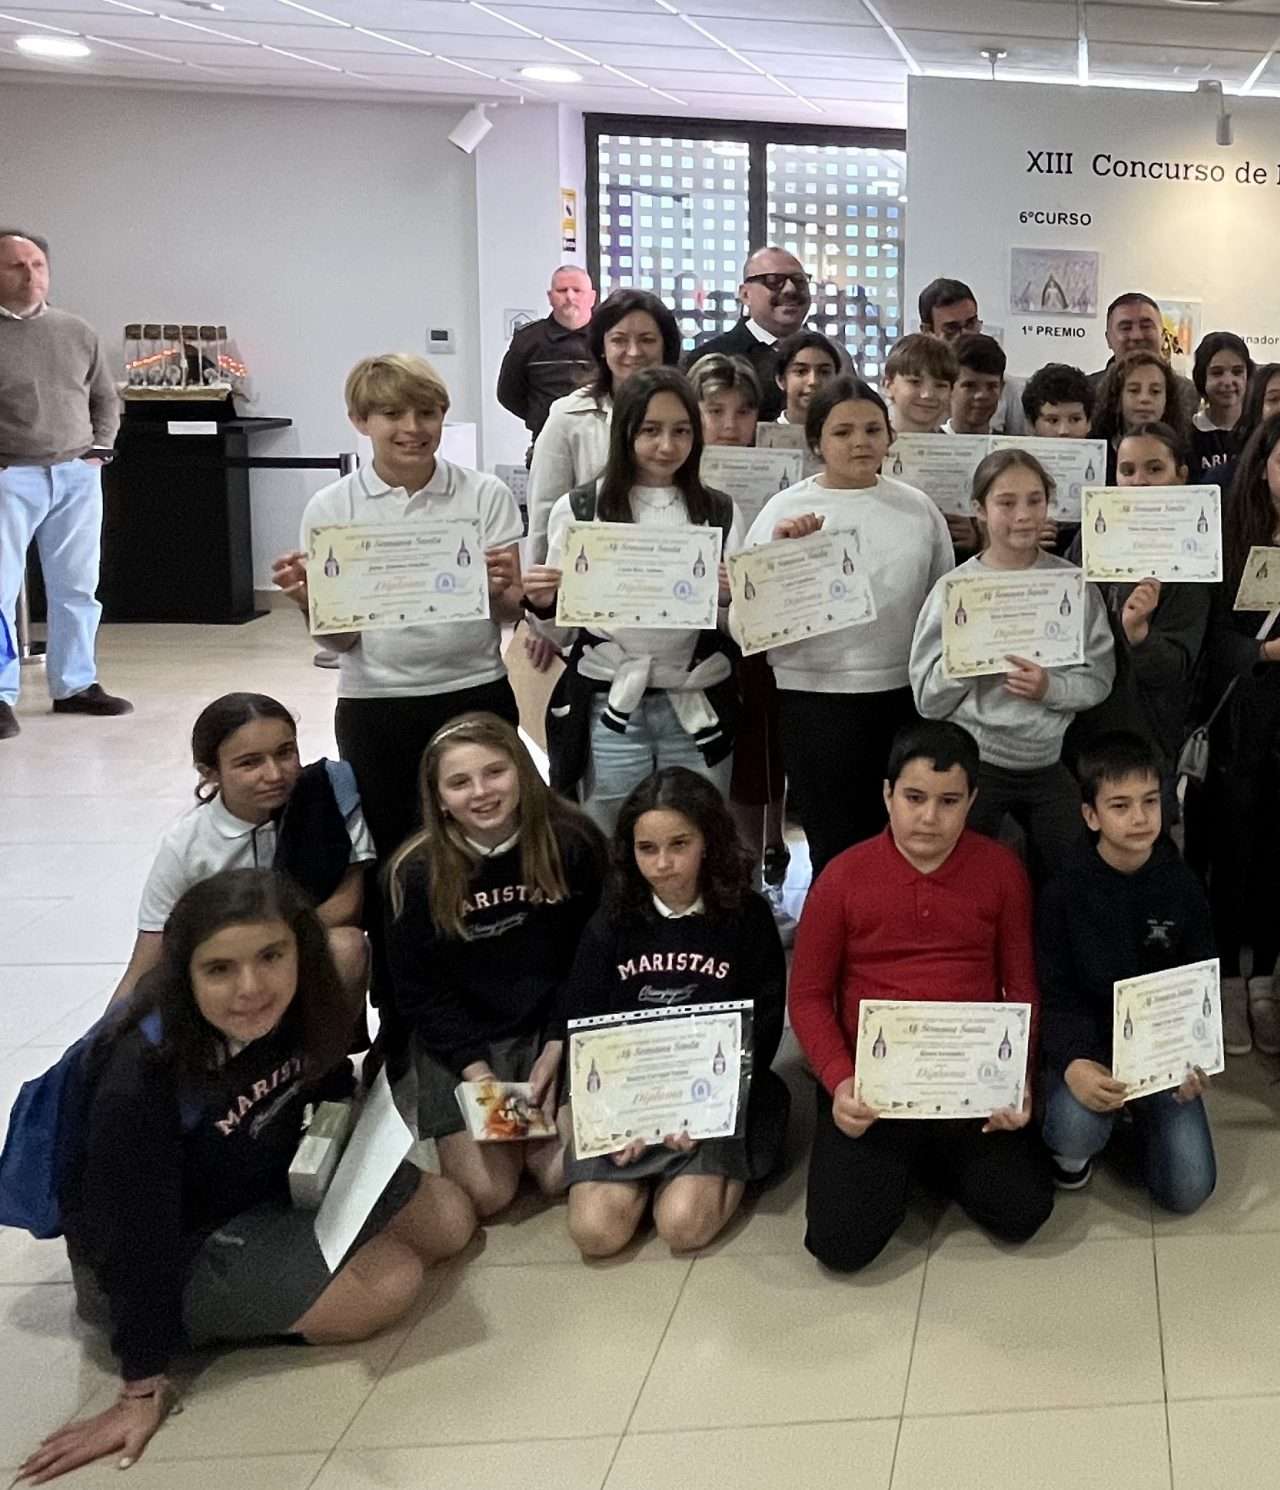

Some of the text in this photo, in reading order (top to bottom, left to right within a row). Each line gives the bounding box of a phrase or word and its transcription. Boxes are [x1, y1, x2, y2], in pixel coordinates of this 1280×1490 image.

[1026, 150, 1073, 175] XIII
[1092, 153, 1225, 183] Concurso
[1235, 161, 1267, 184] de
[1036, 326, 1086, 338] PREMIO
[1241, 335, 1279, 345] nador
[461, 885, 561, 918] ARISTA
[617, 952, 730, 980] MARISTAS
[214, 1057, 301, 1136] MARIST
